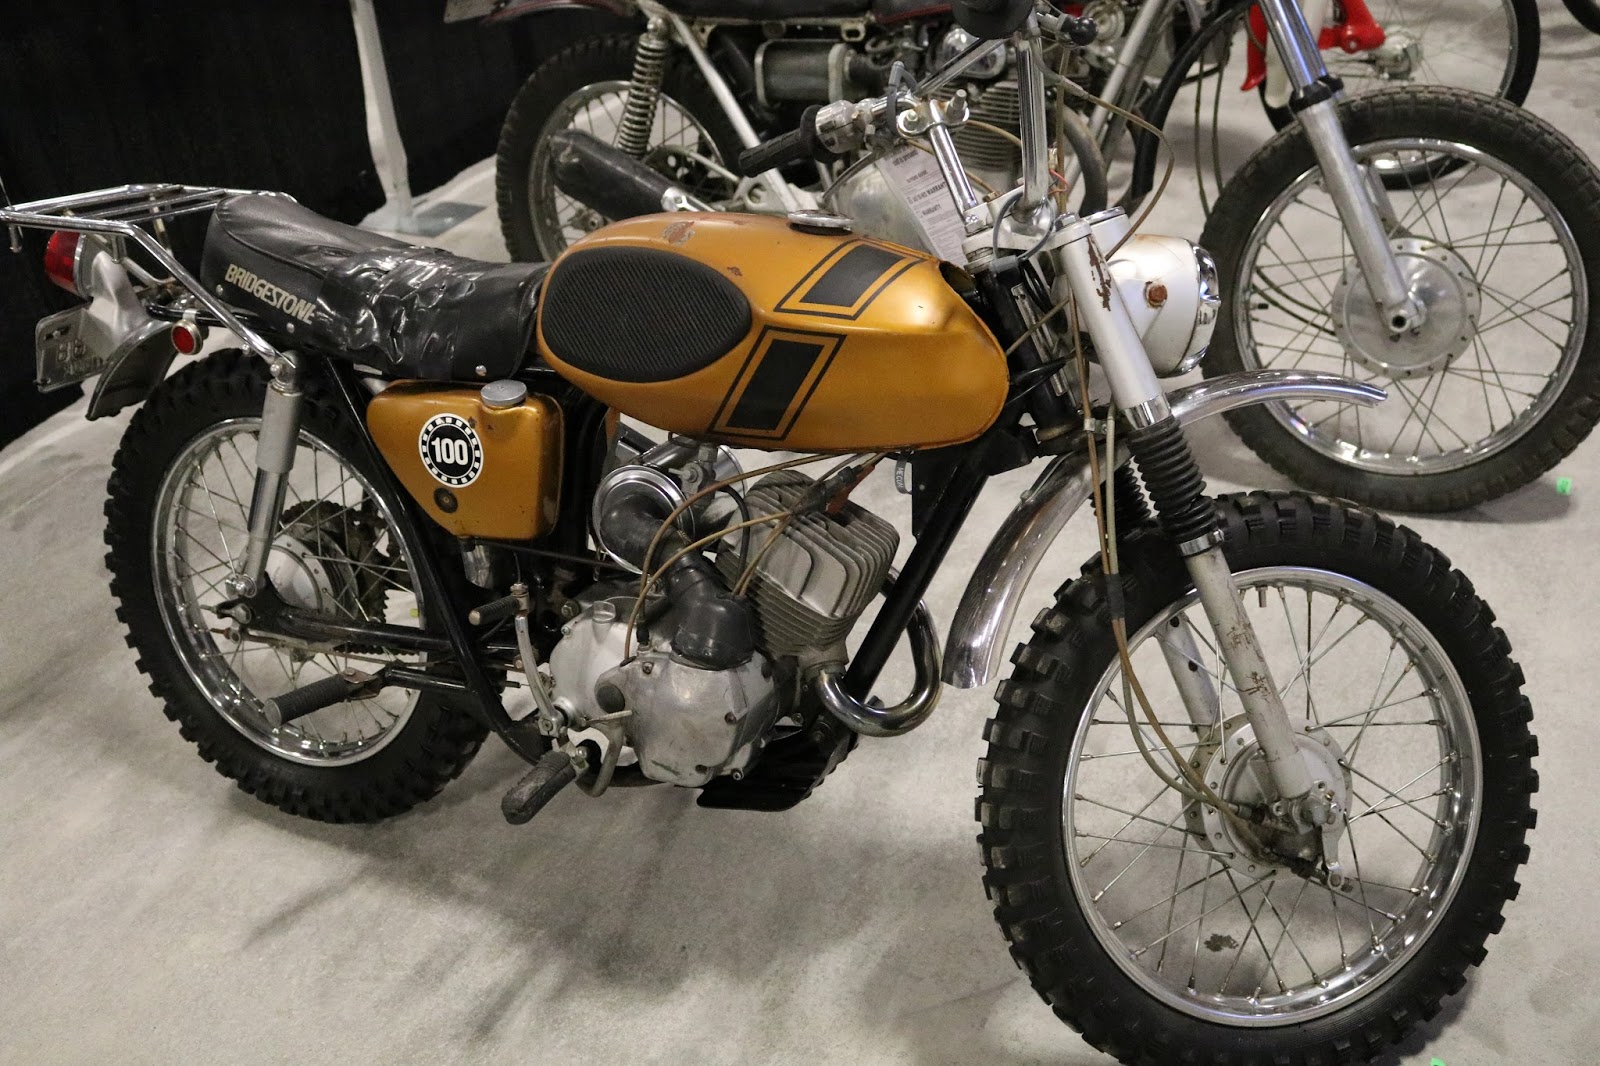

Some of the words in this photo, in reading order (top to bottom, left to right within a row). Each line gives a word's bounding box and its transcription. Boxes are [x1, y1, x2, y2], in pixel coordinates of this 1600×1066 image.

[927, 181, 947, 195] WARRANT
[225, 263, 316, 326] BRIDGESTONE
[431, 437, 468, 465] 100
